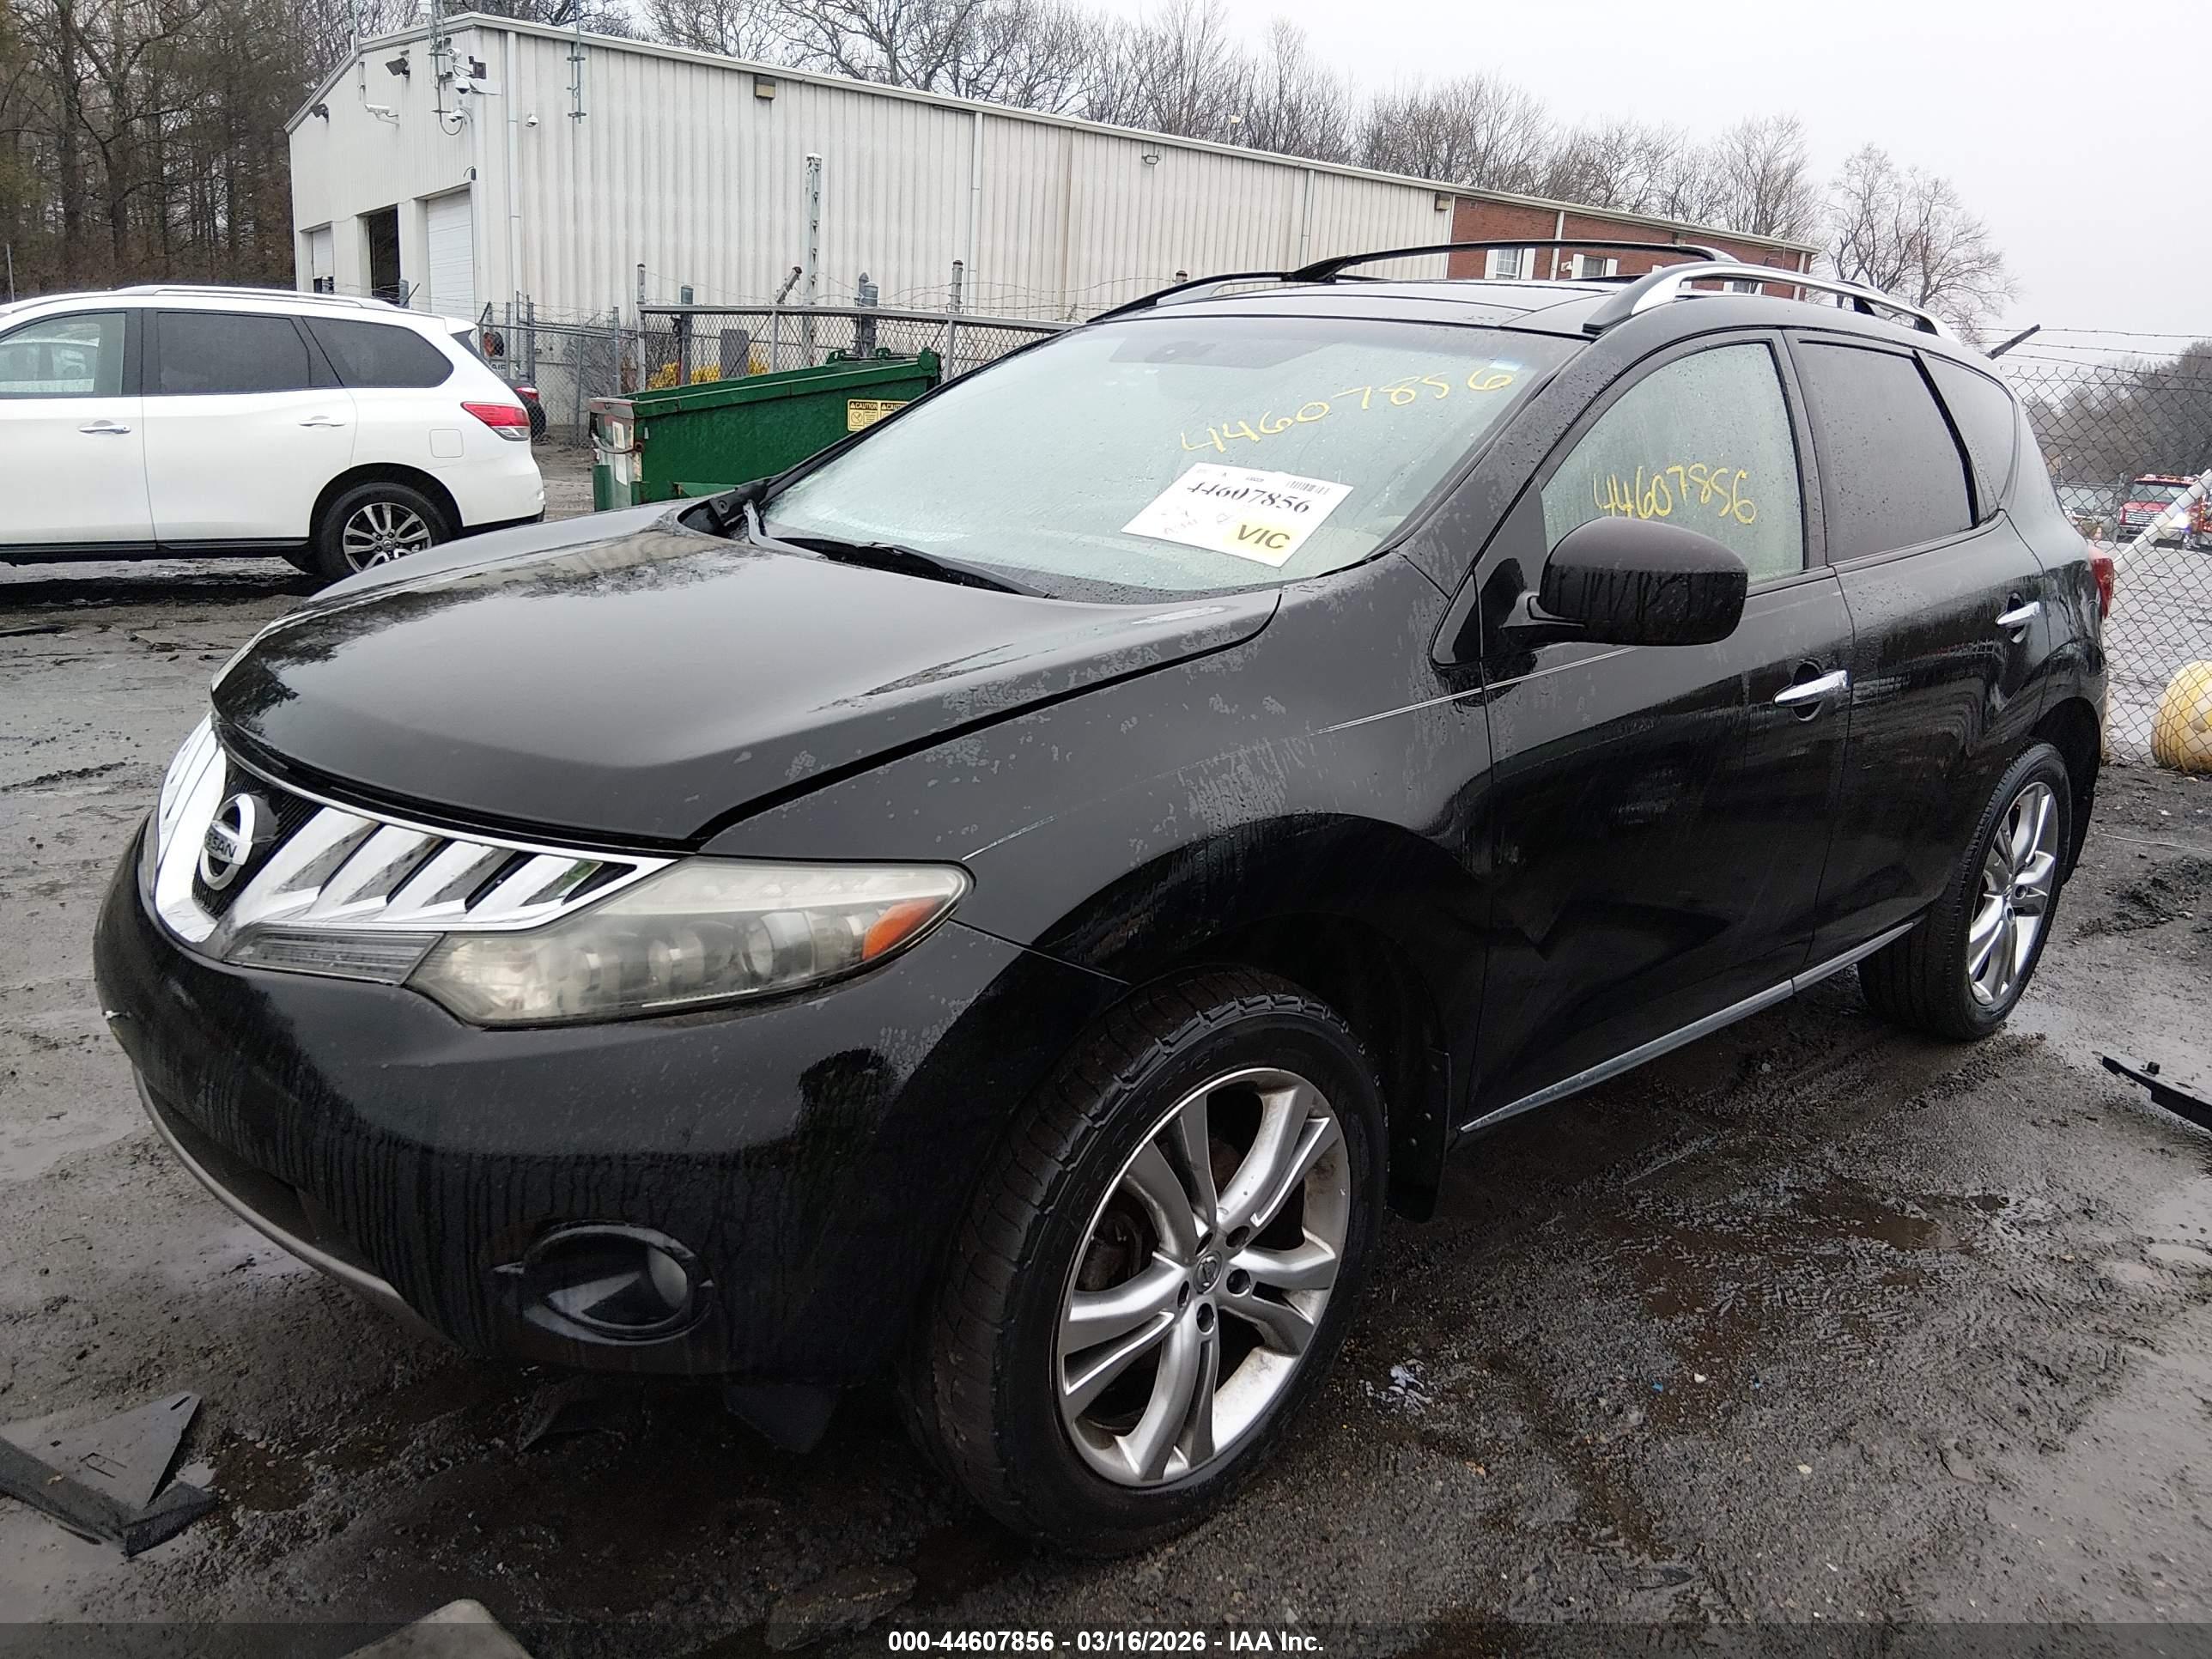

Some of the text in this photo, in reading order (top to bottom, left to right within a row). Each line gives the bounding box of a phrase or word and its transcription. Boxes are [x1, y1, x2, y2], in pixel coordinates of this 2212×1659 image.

[1181, 368, 1513, 453] 44607856
[1188, 482, 1312, 514] 44607856
[1593, 463, 1757, 525] 44607856
[1237, 524, 1290, 550] VIC
